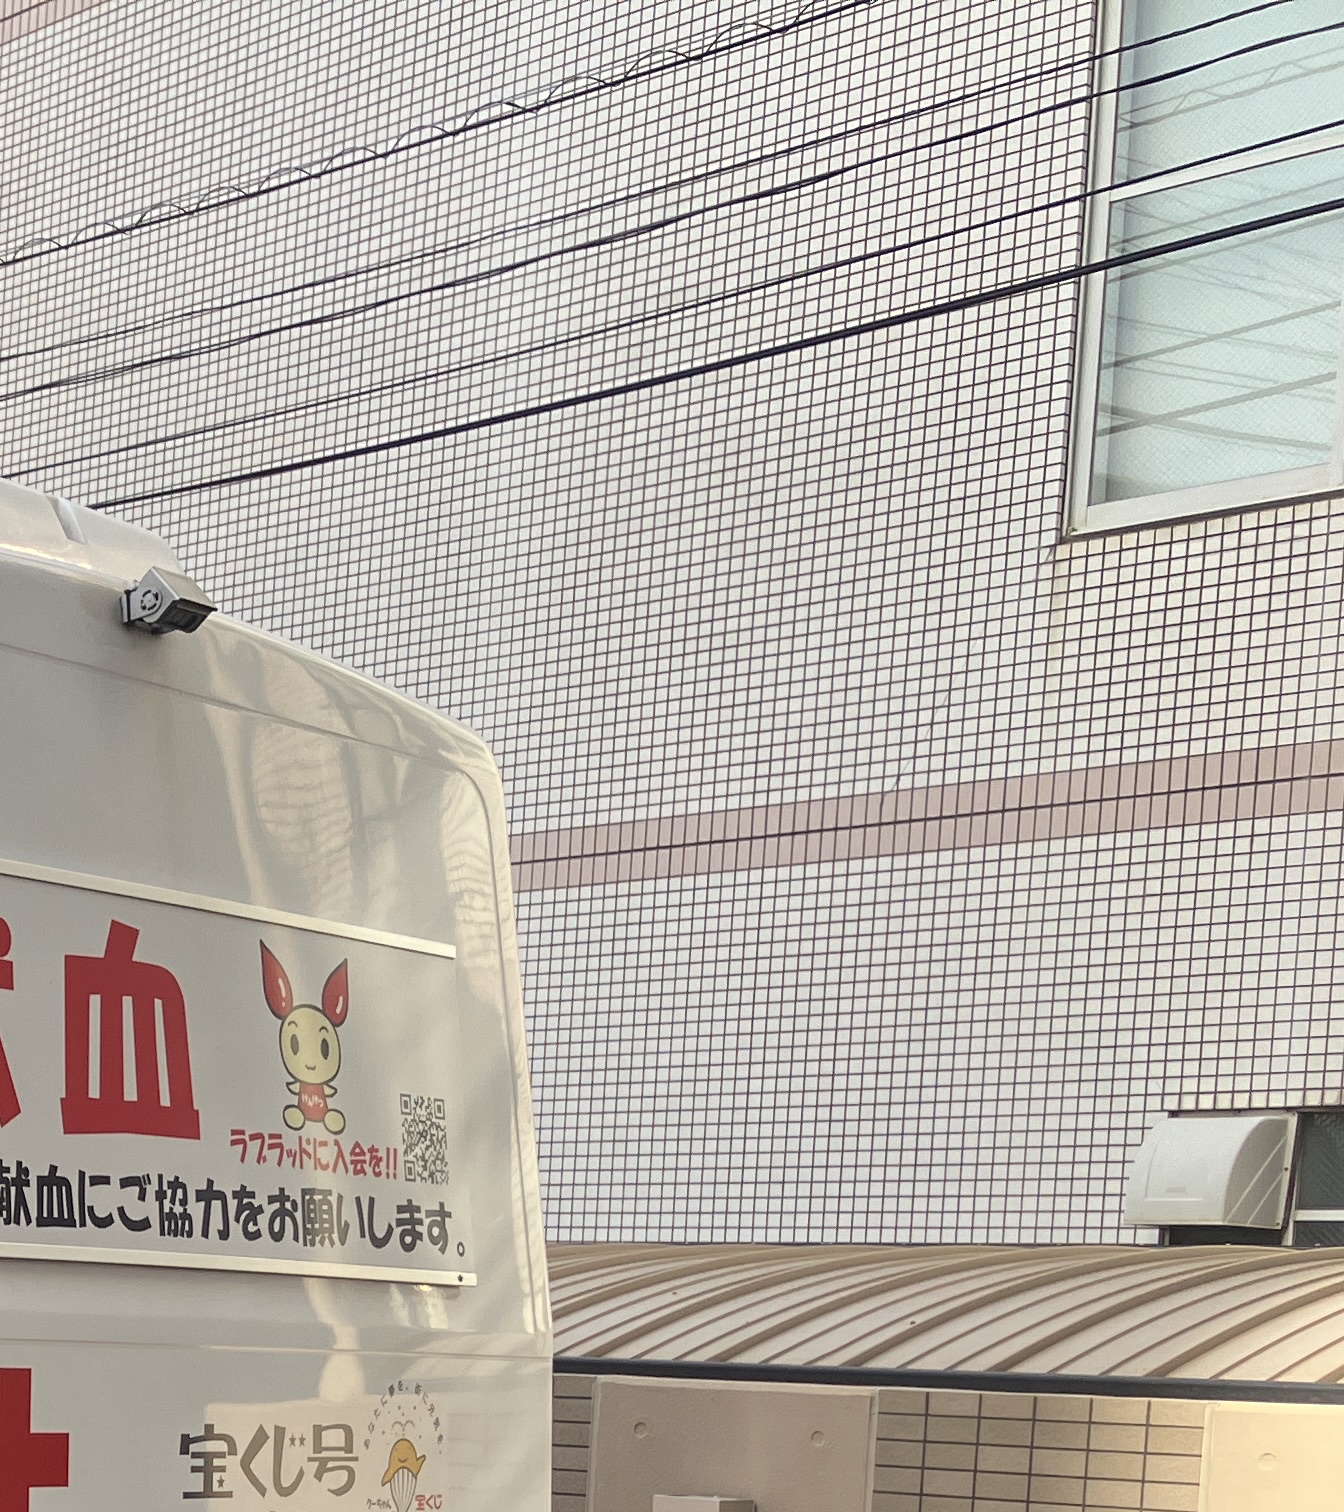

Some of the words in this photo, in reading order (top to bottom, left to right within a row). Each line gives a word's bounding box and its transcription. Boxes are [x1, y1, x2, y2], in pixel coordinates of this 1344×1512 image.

[178, 1423, 359, 1500] 宝くじ号
[415, 1493, 443, 1512] 宝くじ
